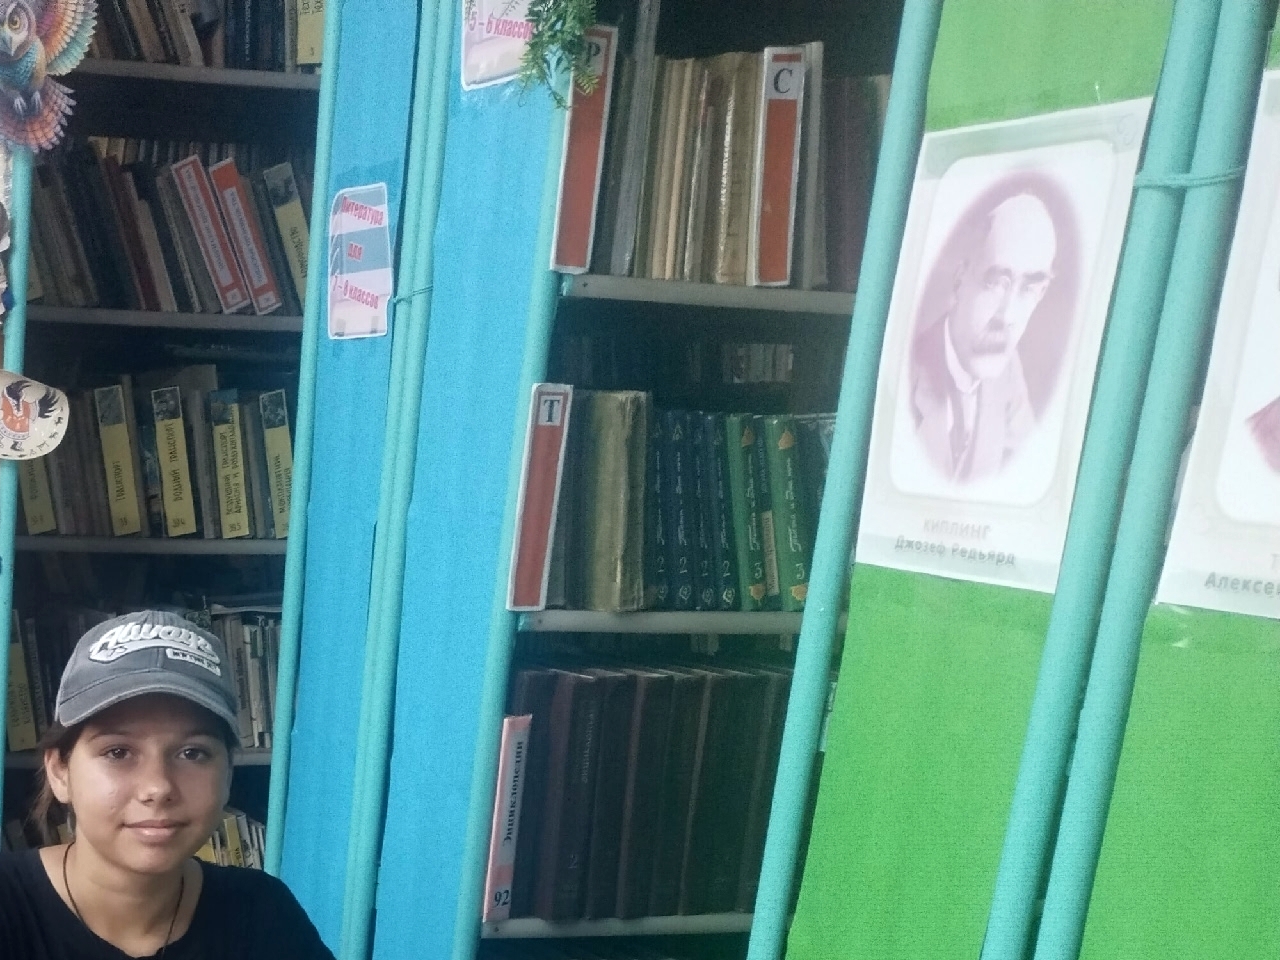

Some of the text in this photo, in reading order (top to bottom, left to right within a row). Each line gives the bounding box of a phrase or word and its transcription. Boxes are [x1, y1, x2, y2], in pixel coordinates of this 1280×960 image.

[773, 68, 794, 95] С
[341, 196, 384, 225] Литература
[348, 243, 363, 261] для
[349, 285, 379, 310] классов
[544, 399, 560, 424] Т
[924, 518, 991, 541] КИПЛИНГ
[894, 534, 1016, 566] Джозеф Редьярд
[796, 562, 804, 580] 3
[503, 741, 524, 847] Энциклопедии
[494, 890, 510, 908] 92
